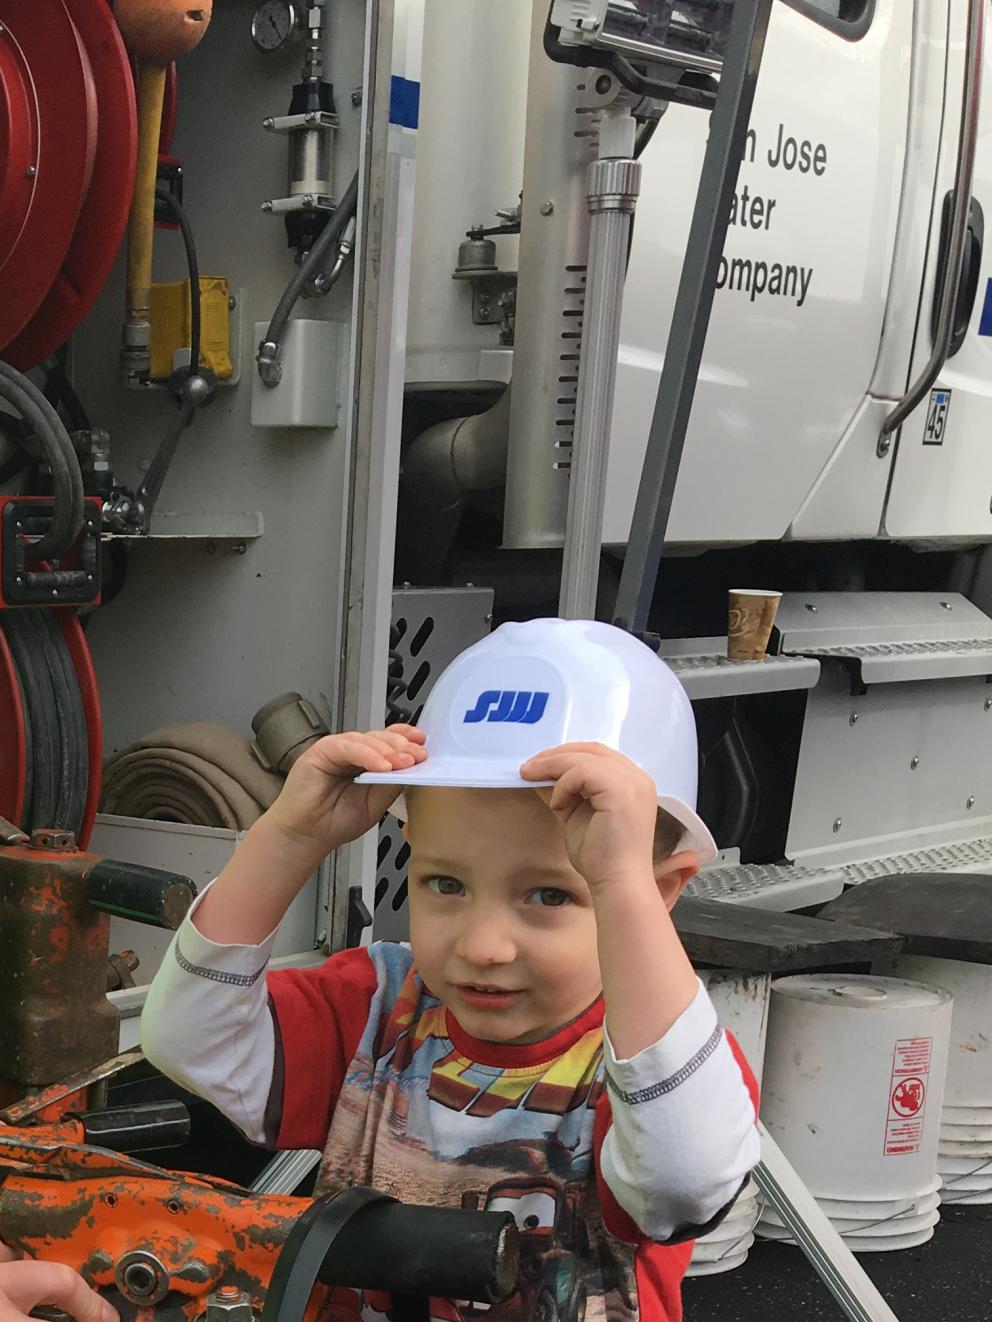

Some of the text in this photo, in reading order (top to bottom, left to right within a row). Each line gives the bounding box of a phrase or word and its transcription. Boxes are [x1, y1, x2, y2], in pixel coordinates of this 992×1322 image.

[767, 123, 827, 176] Jose
[728, 185, 777, 230] ater
[716, 255, 813, 307] ompany
[927, 404, 946, 440] 45
